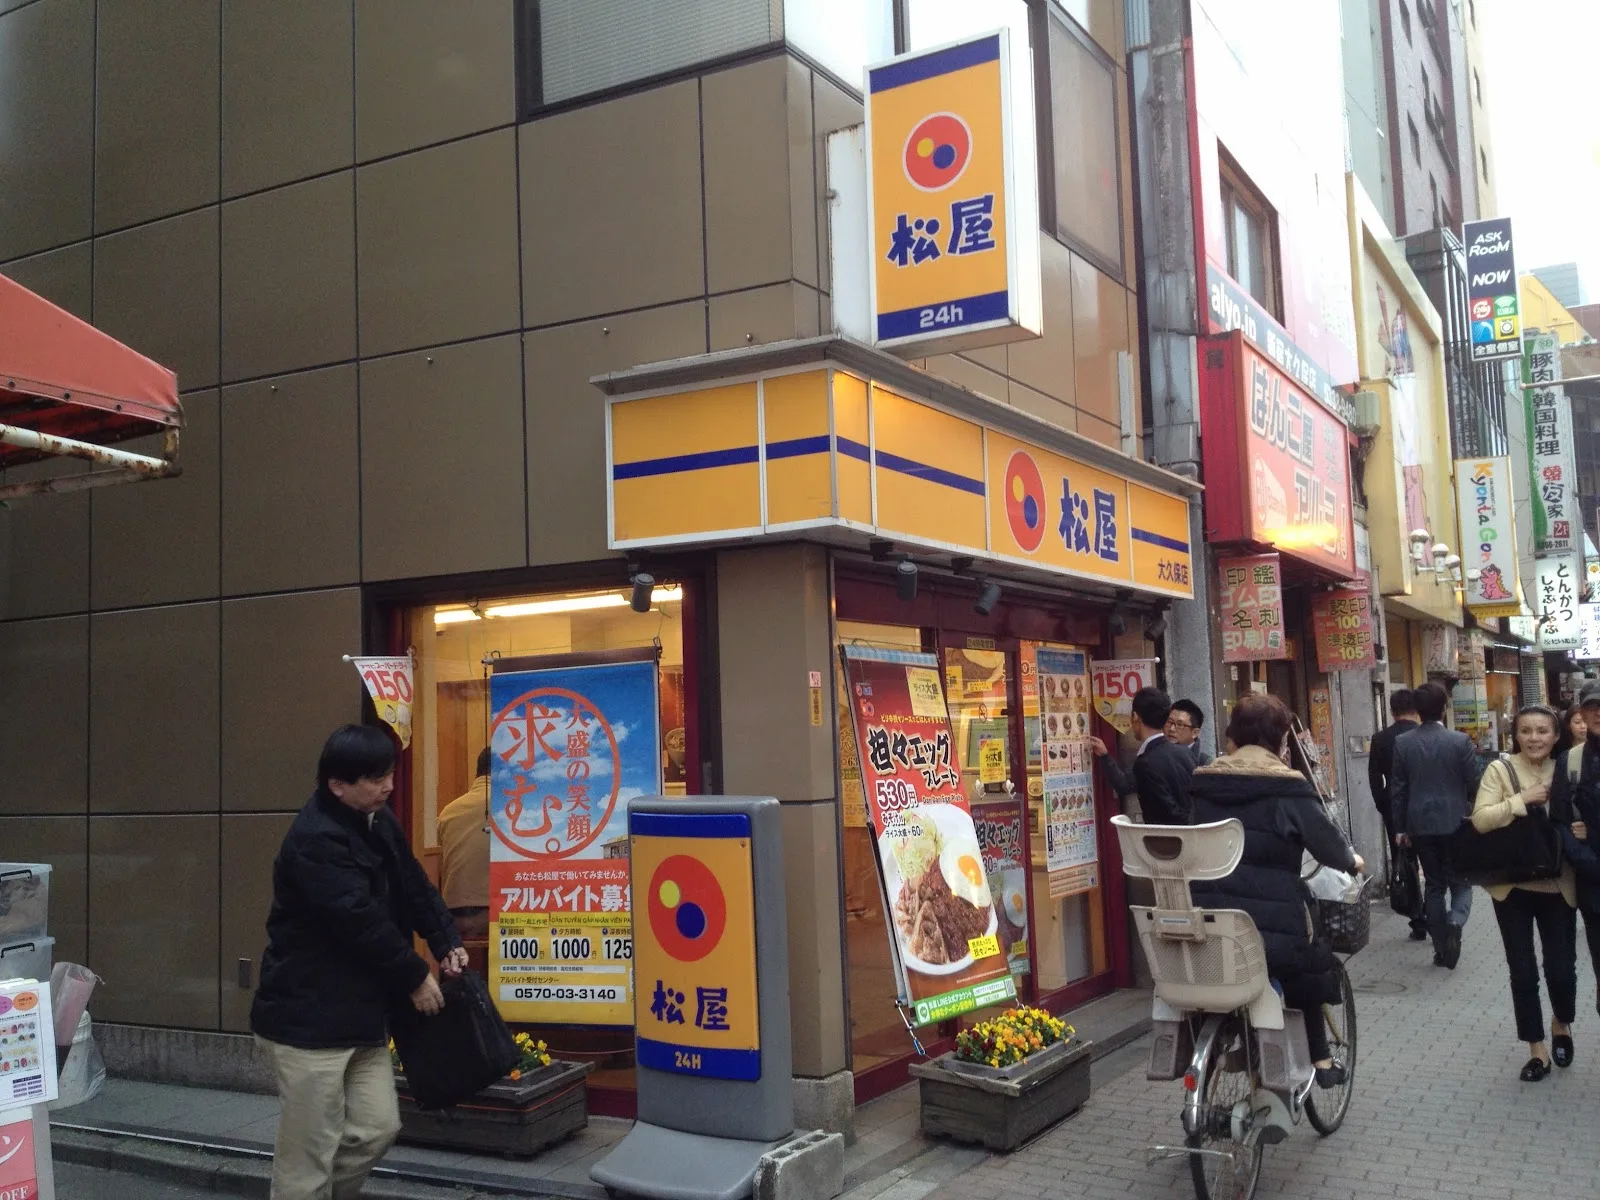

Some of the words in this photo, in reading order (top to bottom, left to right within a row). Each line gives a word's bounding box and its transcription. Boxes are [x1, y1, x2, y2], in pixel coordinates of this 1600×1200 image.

[886, 194, 996, 267] 松屋
[1475, 231, 1502, 244] ASK
[1472, 269, 1511, 287] NOW
[919, 305, 963, 328] 24h
[1475, 341, 1519, 356] 全室個室
[1251, 356, 1314, 468] はんこ屋
[1058, 477, 1119, 563] 松屋
[1554, 522, 1569, 536] 2F
[1479, 527, 1498, 563] Gon
[1158, 558, 1189, 585] 大久保店
[1221, 587, 1277, 609] ゴム印
[1557, 563, 1573, 622] とんかつ
[1232, 610, 1279, 629] 名刺
[1222, 628, 1266, 652] 印刷
[364, 670, 413, 703] 150
[1094, 671, 1142, 699] 150
[565, 701, 591, 841] 大盛の笑顔
[922, 768, 958, 787] プレート
[515, 871, 629, 881] あなたも松屋で働いてみませんか。
[515, 988, 616, 1000] 0570-03-3140
[651, 980, 730, 1031] 松屋
[674, 1051, 702, 1069] 24H
